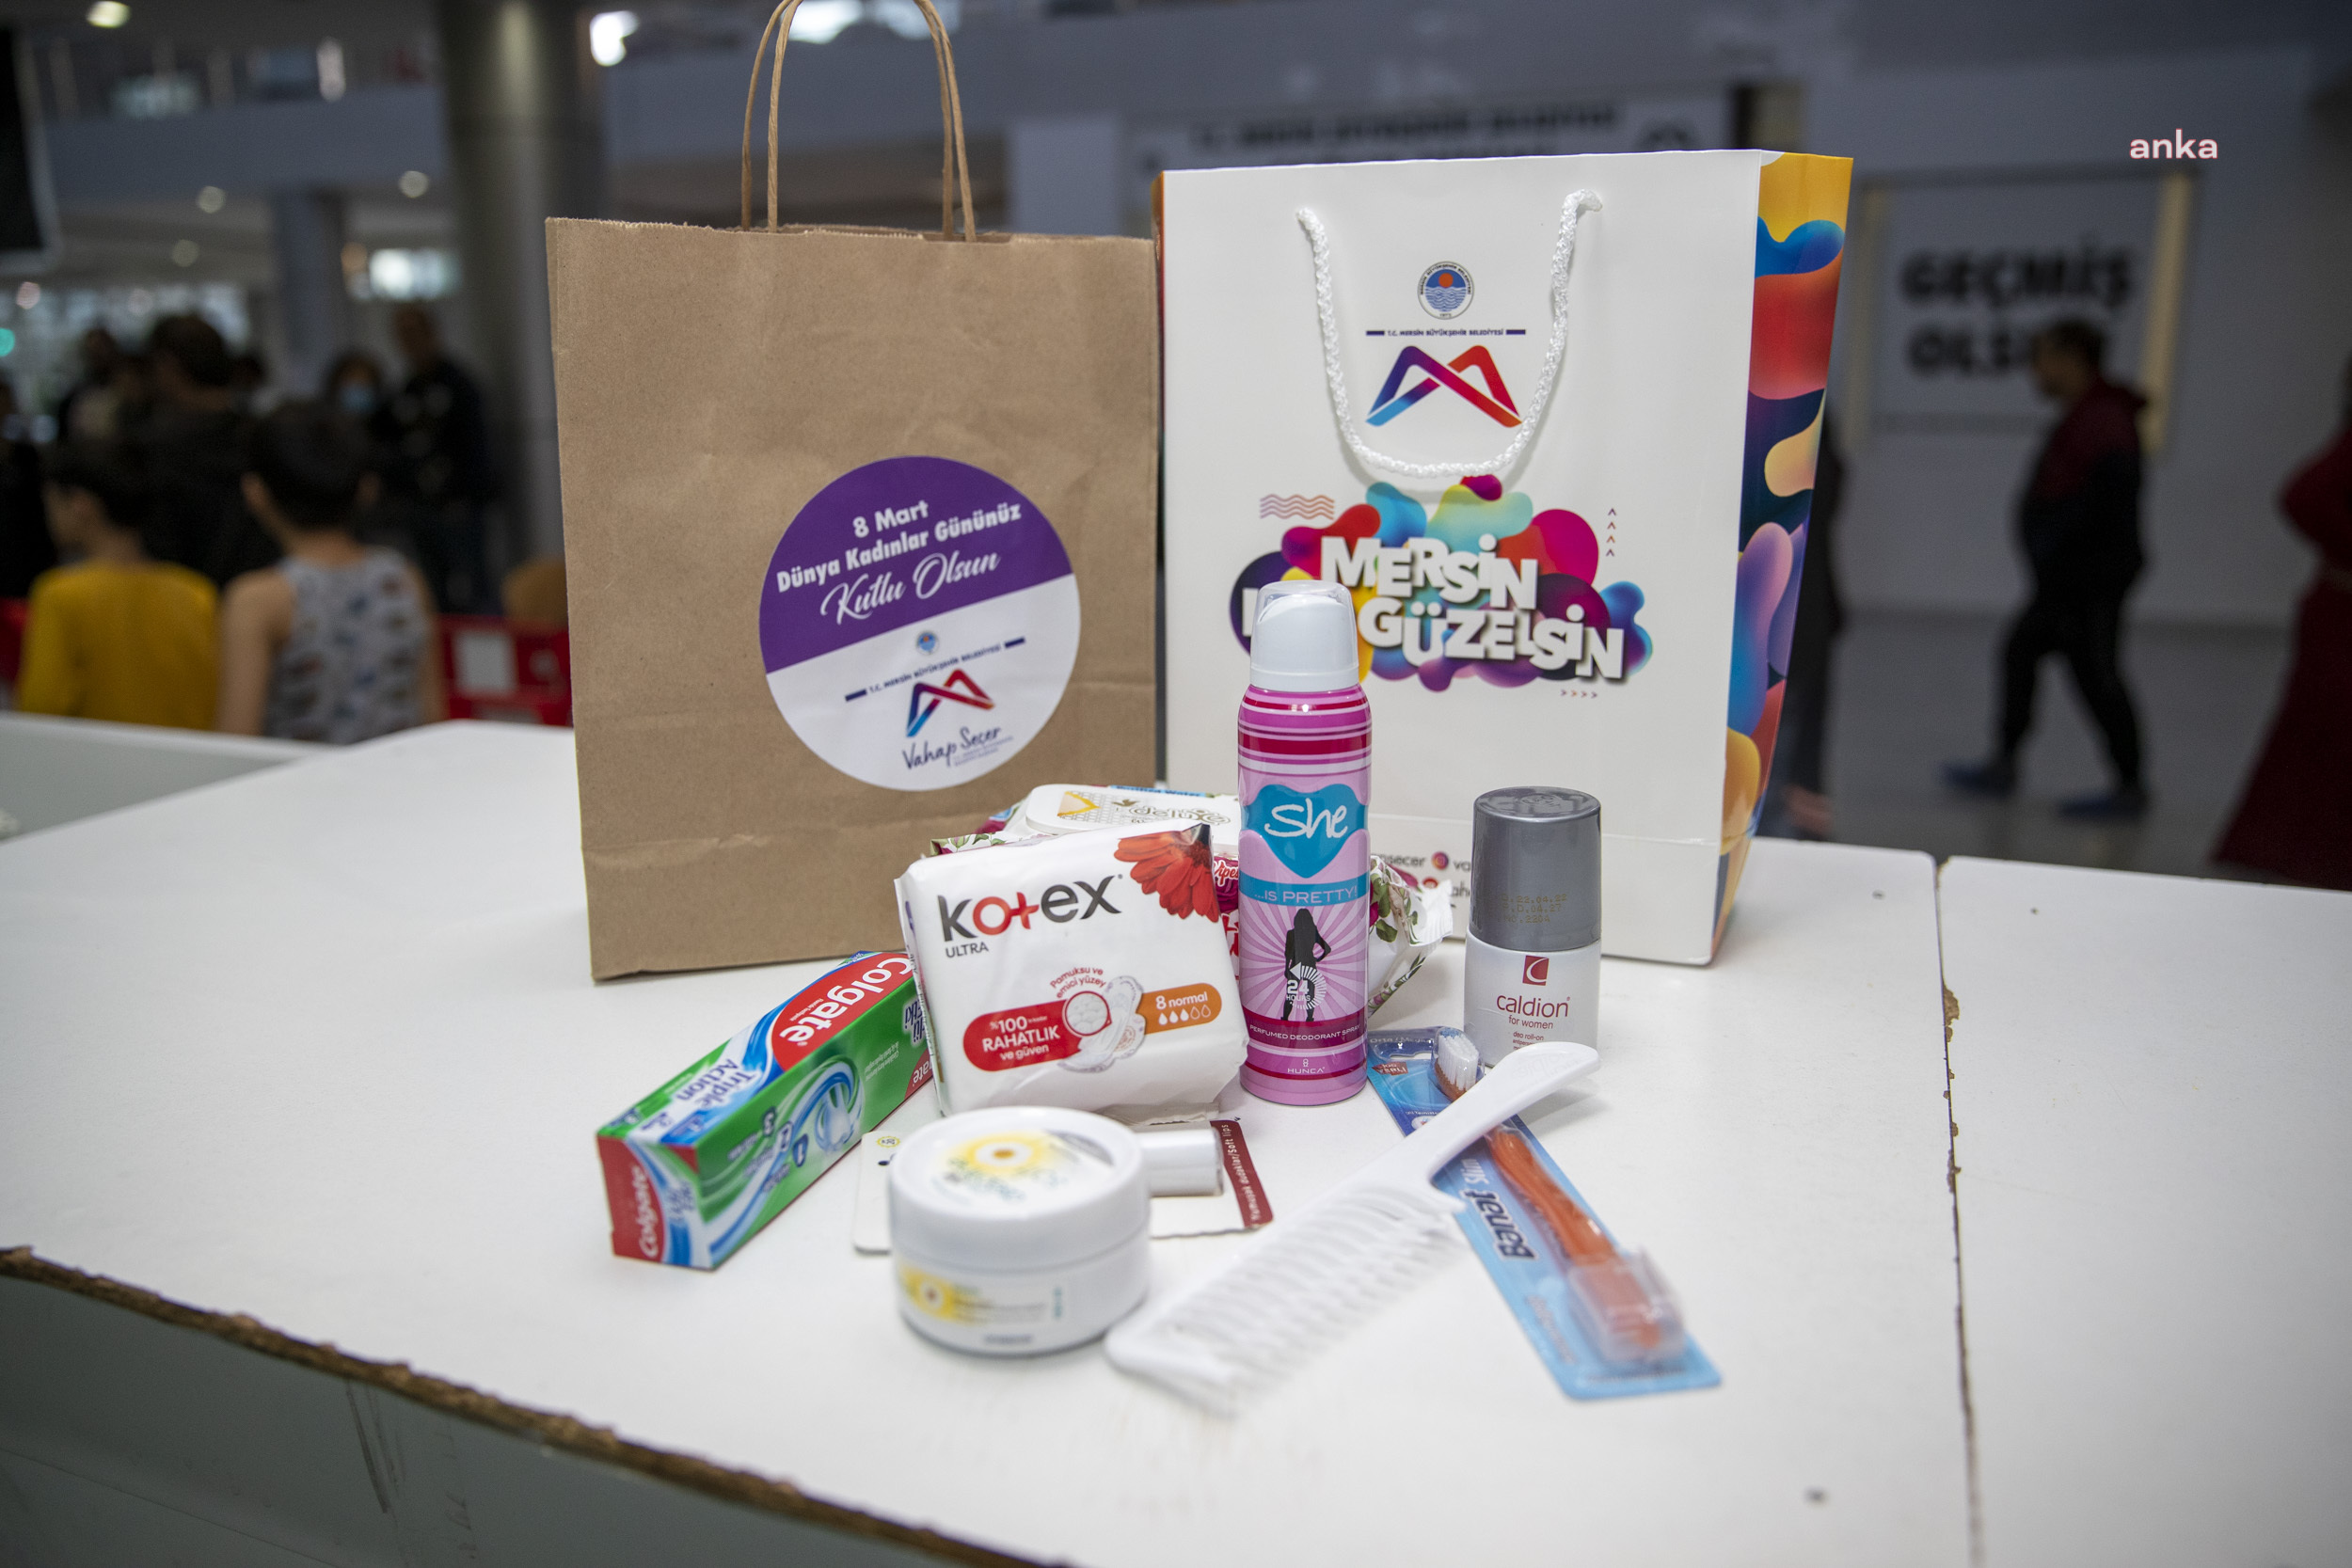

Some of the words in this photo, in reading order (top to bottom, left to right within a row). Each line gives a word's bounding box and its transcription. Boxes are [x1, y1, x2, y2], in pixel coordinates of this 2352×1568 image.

[852, 515, 870, 539] 8
[874, 499, 930, 533] Mart
[776, 559, 841, 593] Dünya
[845, 530, 930, 571] Kadınlar
[934, 502, 1022, 543] Gününüz
[1320, 533, 1538, 610] MERSİN
[819, 572, 906, 626] Kutlu
[912, 550, 1001, 599] Olsun
[1358, 595, 1625, 680] GÜZELSİN
[901, 739, 958, 770] Vahap
[1263, 797, 1348, 839] She
[1282, 885, 1359, 904] PRETTY!
[945, 942, 990, 958] ULTRA
[1049, 967, 1091, 990] Pamuksu
[1091, 967, 1104, 976] ve
[1056, 978, 1078, 1000] emici
[1078, 975, 1107, 989] yüzey
[1287, 979, 1310, 994] 24
[778, 957, 914, 1046] Colgate
[1155, 995, 1167, 1010] 8
[1168, 990, 1208, 1007] normal
[1496, 994, 1569, 1018] caldion
[1249, 1023, 1289, 1040] PERFUMED
[1290, 1031, 1341, 1041] DEODORANT
[1342, 1023, 1360, 1036] SPRAY
[1508, 1014, 1520, 1025] for
[1521, 1019, 1554, 1030] women
[981, 1024, 1061, 1053] RAHATLIK
[1513, 1031, 1524, 1039] deo
[1524, 1033, 1545, 1041] roll-on
[999, 1051, 1014, 1062] ve
[1014, 1043, 1050, 1061] güven
[675, 1058, 739, 1102] Action
[696, 1067, 756, 1110] Triple
[1221, 1124, 1232, 1137] lips
[1461, 1188, 1537, 1261] Banat
